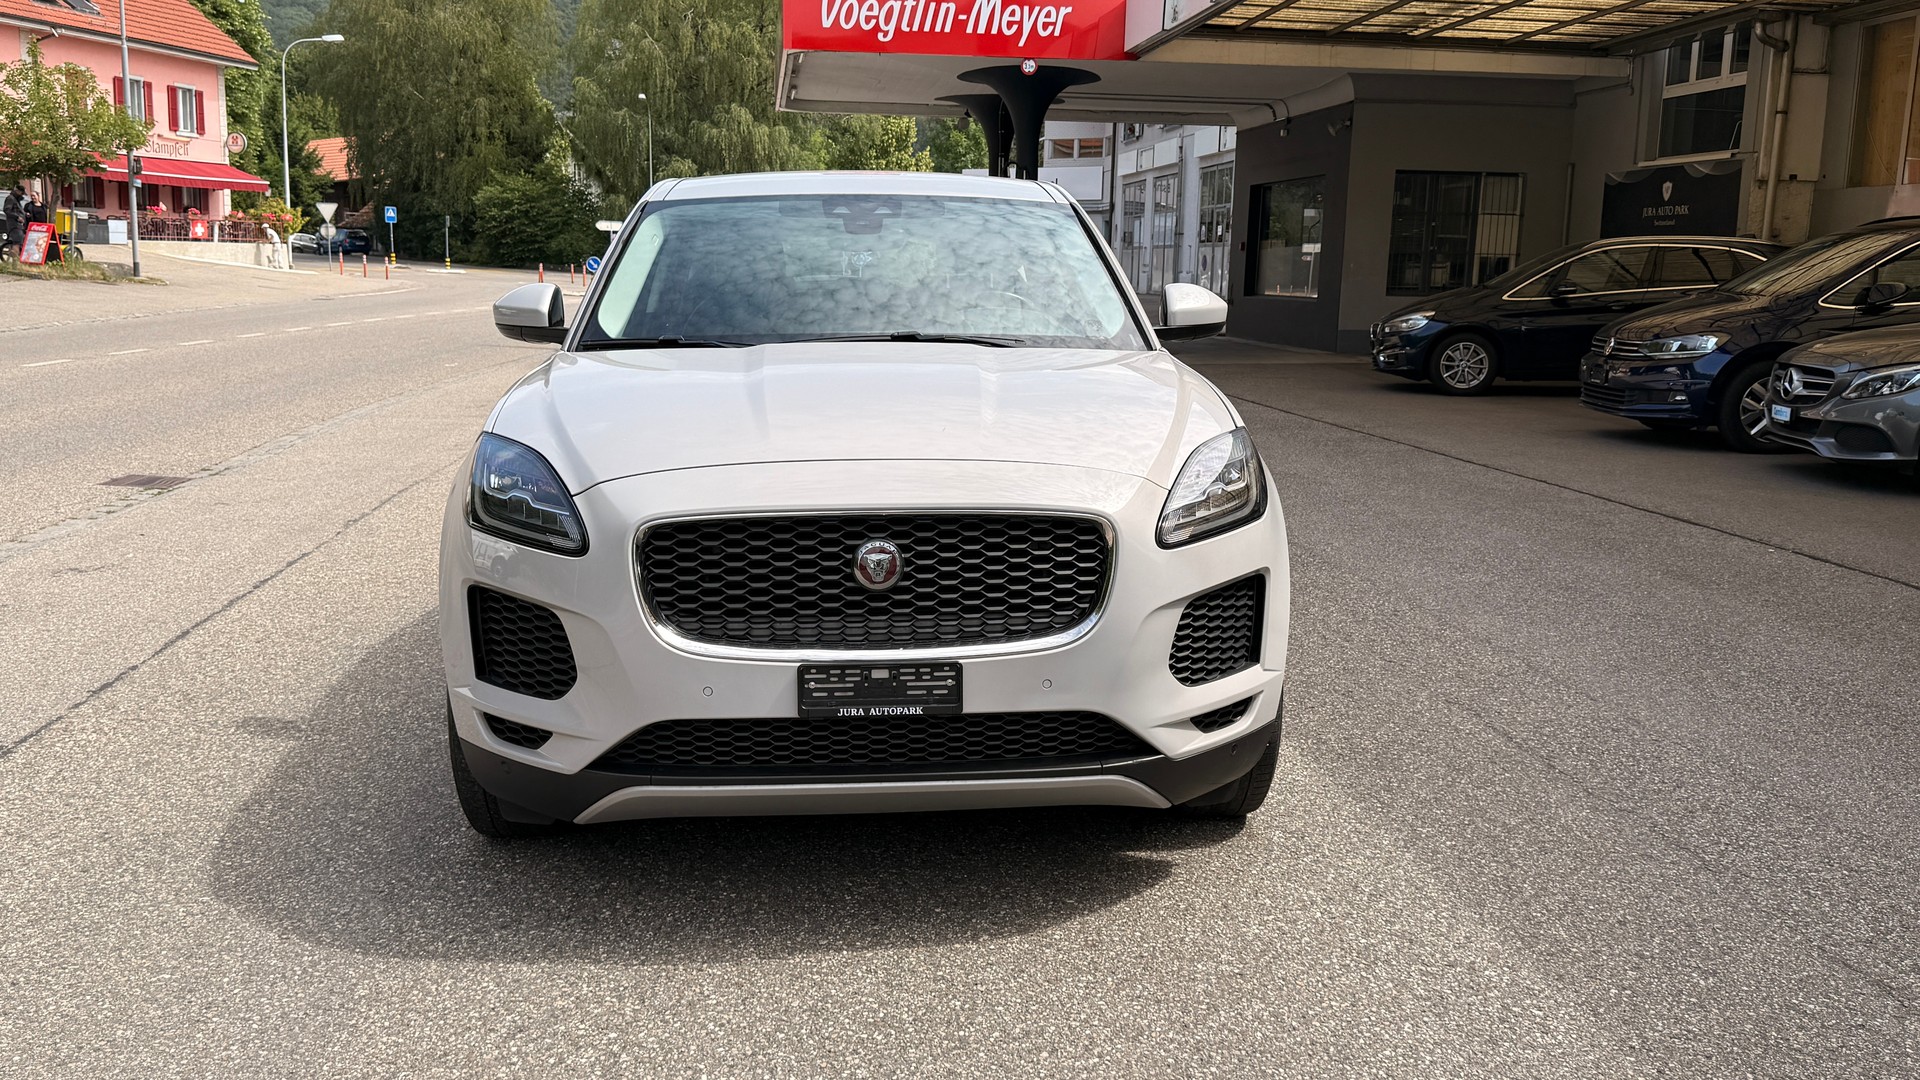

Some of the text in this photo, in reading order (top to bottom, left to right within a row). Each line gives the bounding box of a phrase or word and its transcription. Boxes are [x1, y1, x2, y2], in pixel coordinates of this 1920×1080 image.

[821, 0, 1072, 47] Voegtlin-Meyer
[1643, 205, 1690, 217] JURA AUTO PARK
[837, 706, 924, 717] JURA AUTOPARK
